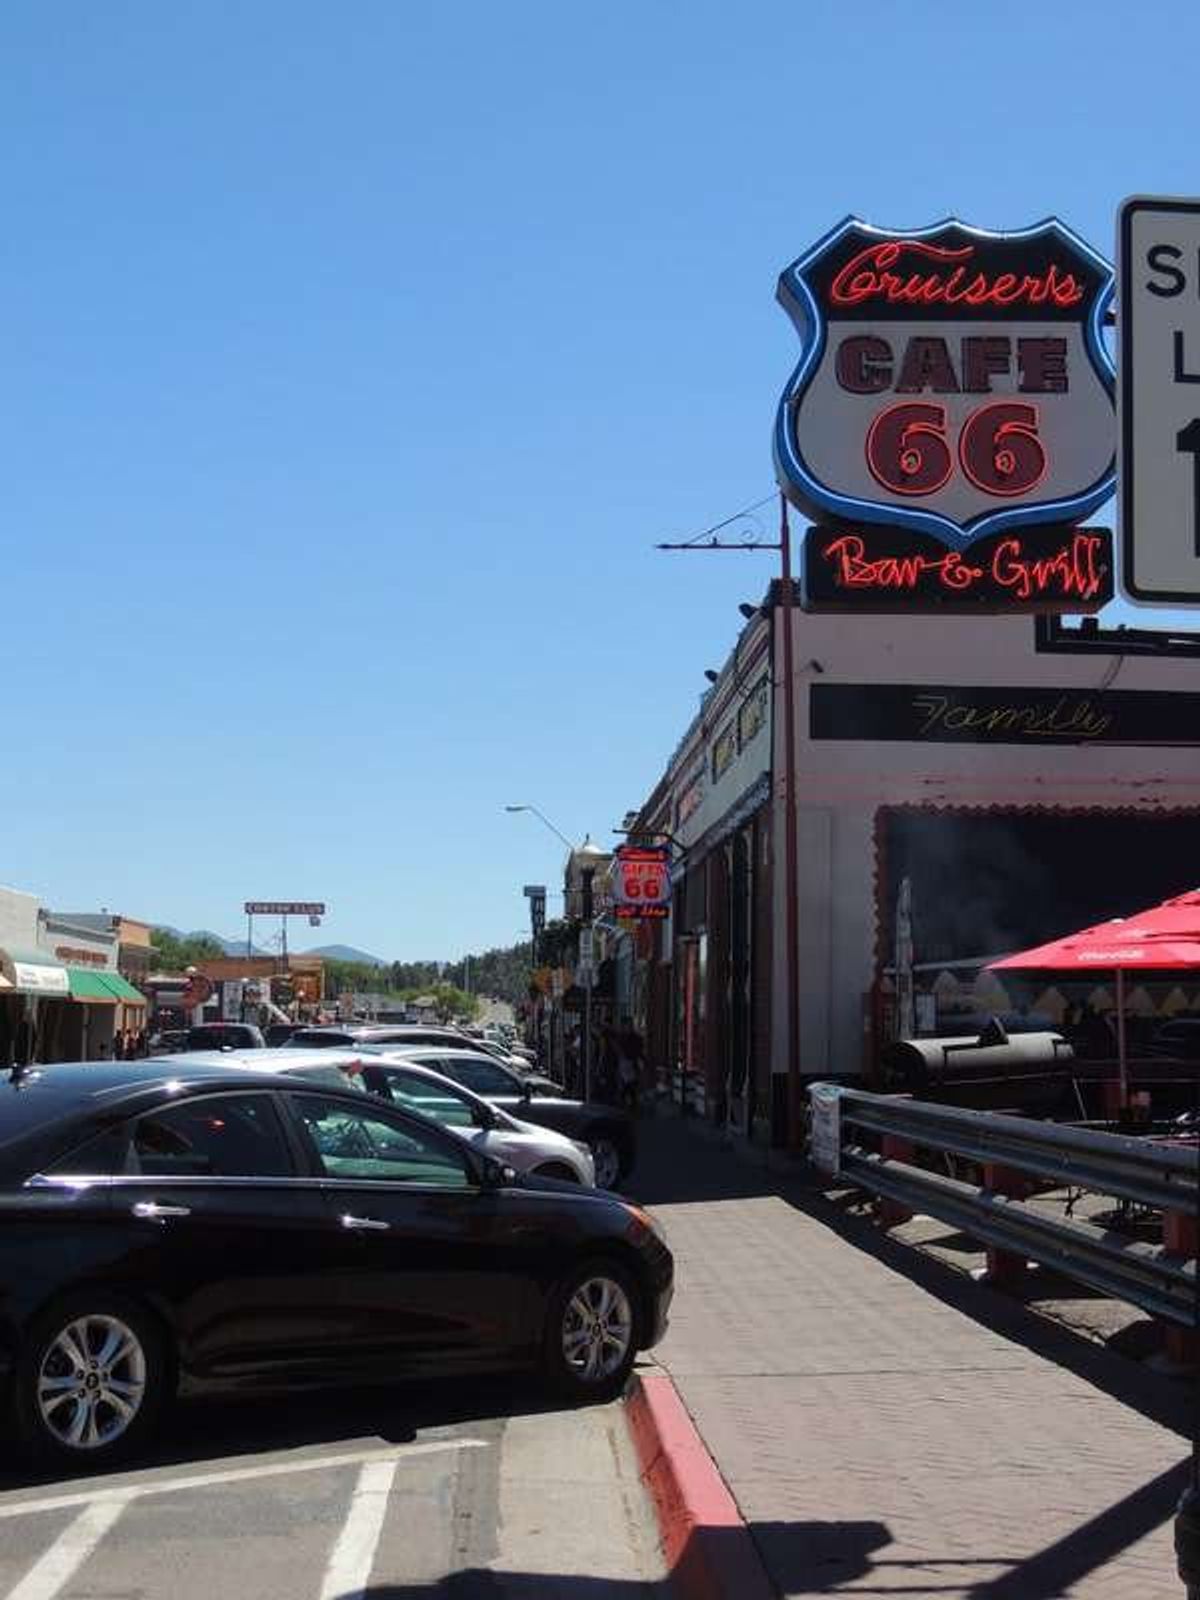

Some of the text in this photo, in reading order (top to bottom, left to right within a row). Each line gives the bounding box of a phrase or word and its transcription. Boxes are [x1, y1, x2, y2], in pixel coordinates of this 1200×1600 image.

[1145, 244, 1200, 298] S
[834, 335, 1069, 395] CAFE
[865, 402, 1048, 496] 66
[825, 535, 1104, 598] Bar & Grill
[625, 879, 660, 899] 66
